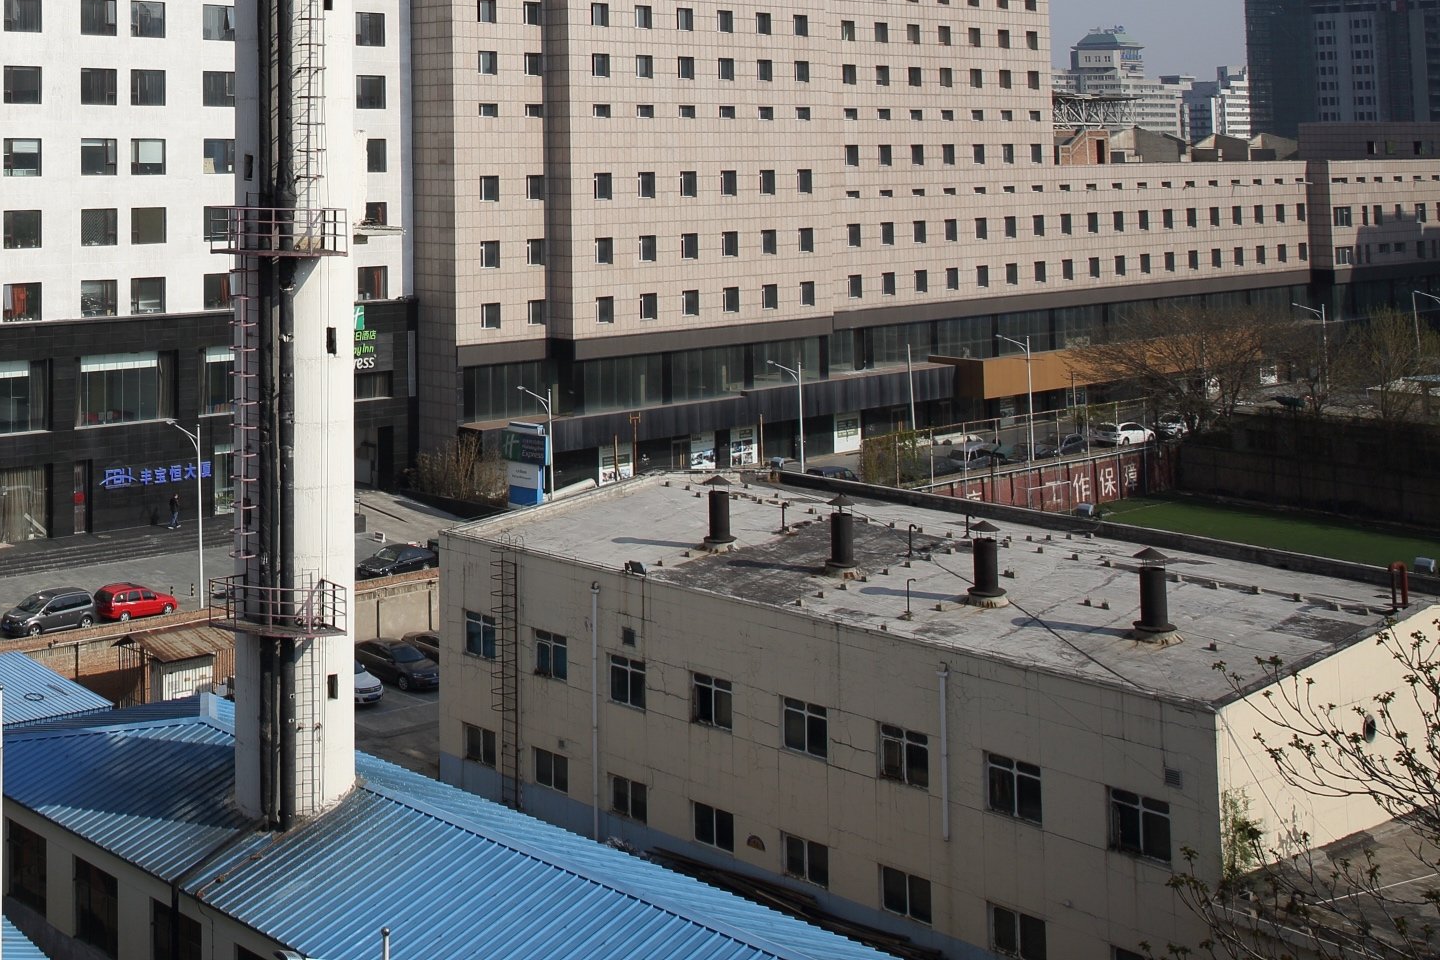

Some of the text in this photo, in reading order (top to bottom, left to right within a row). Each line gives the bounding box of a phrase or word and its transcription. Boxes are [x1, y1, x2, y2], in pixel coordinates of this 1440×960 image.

[354, 330, 377, 341] 日酒店
[354, 357, 375, 369] ress
[140, 461, 212, 485] 丰宝恒大厦
[1045, 464, 1138, 503] 工作保障
